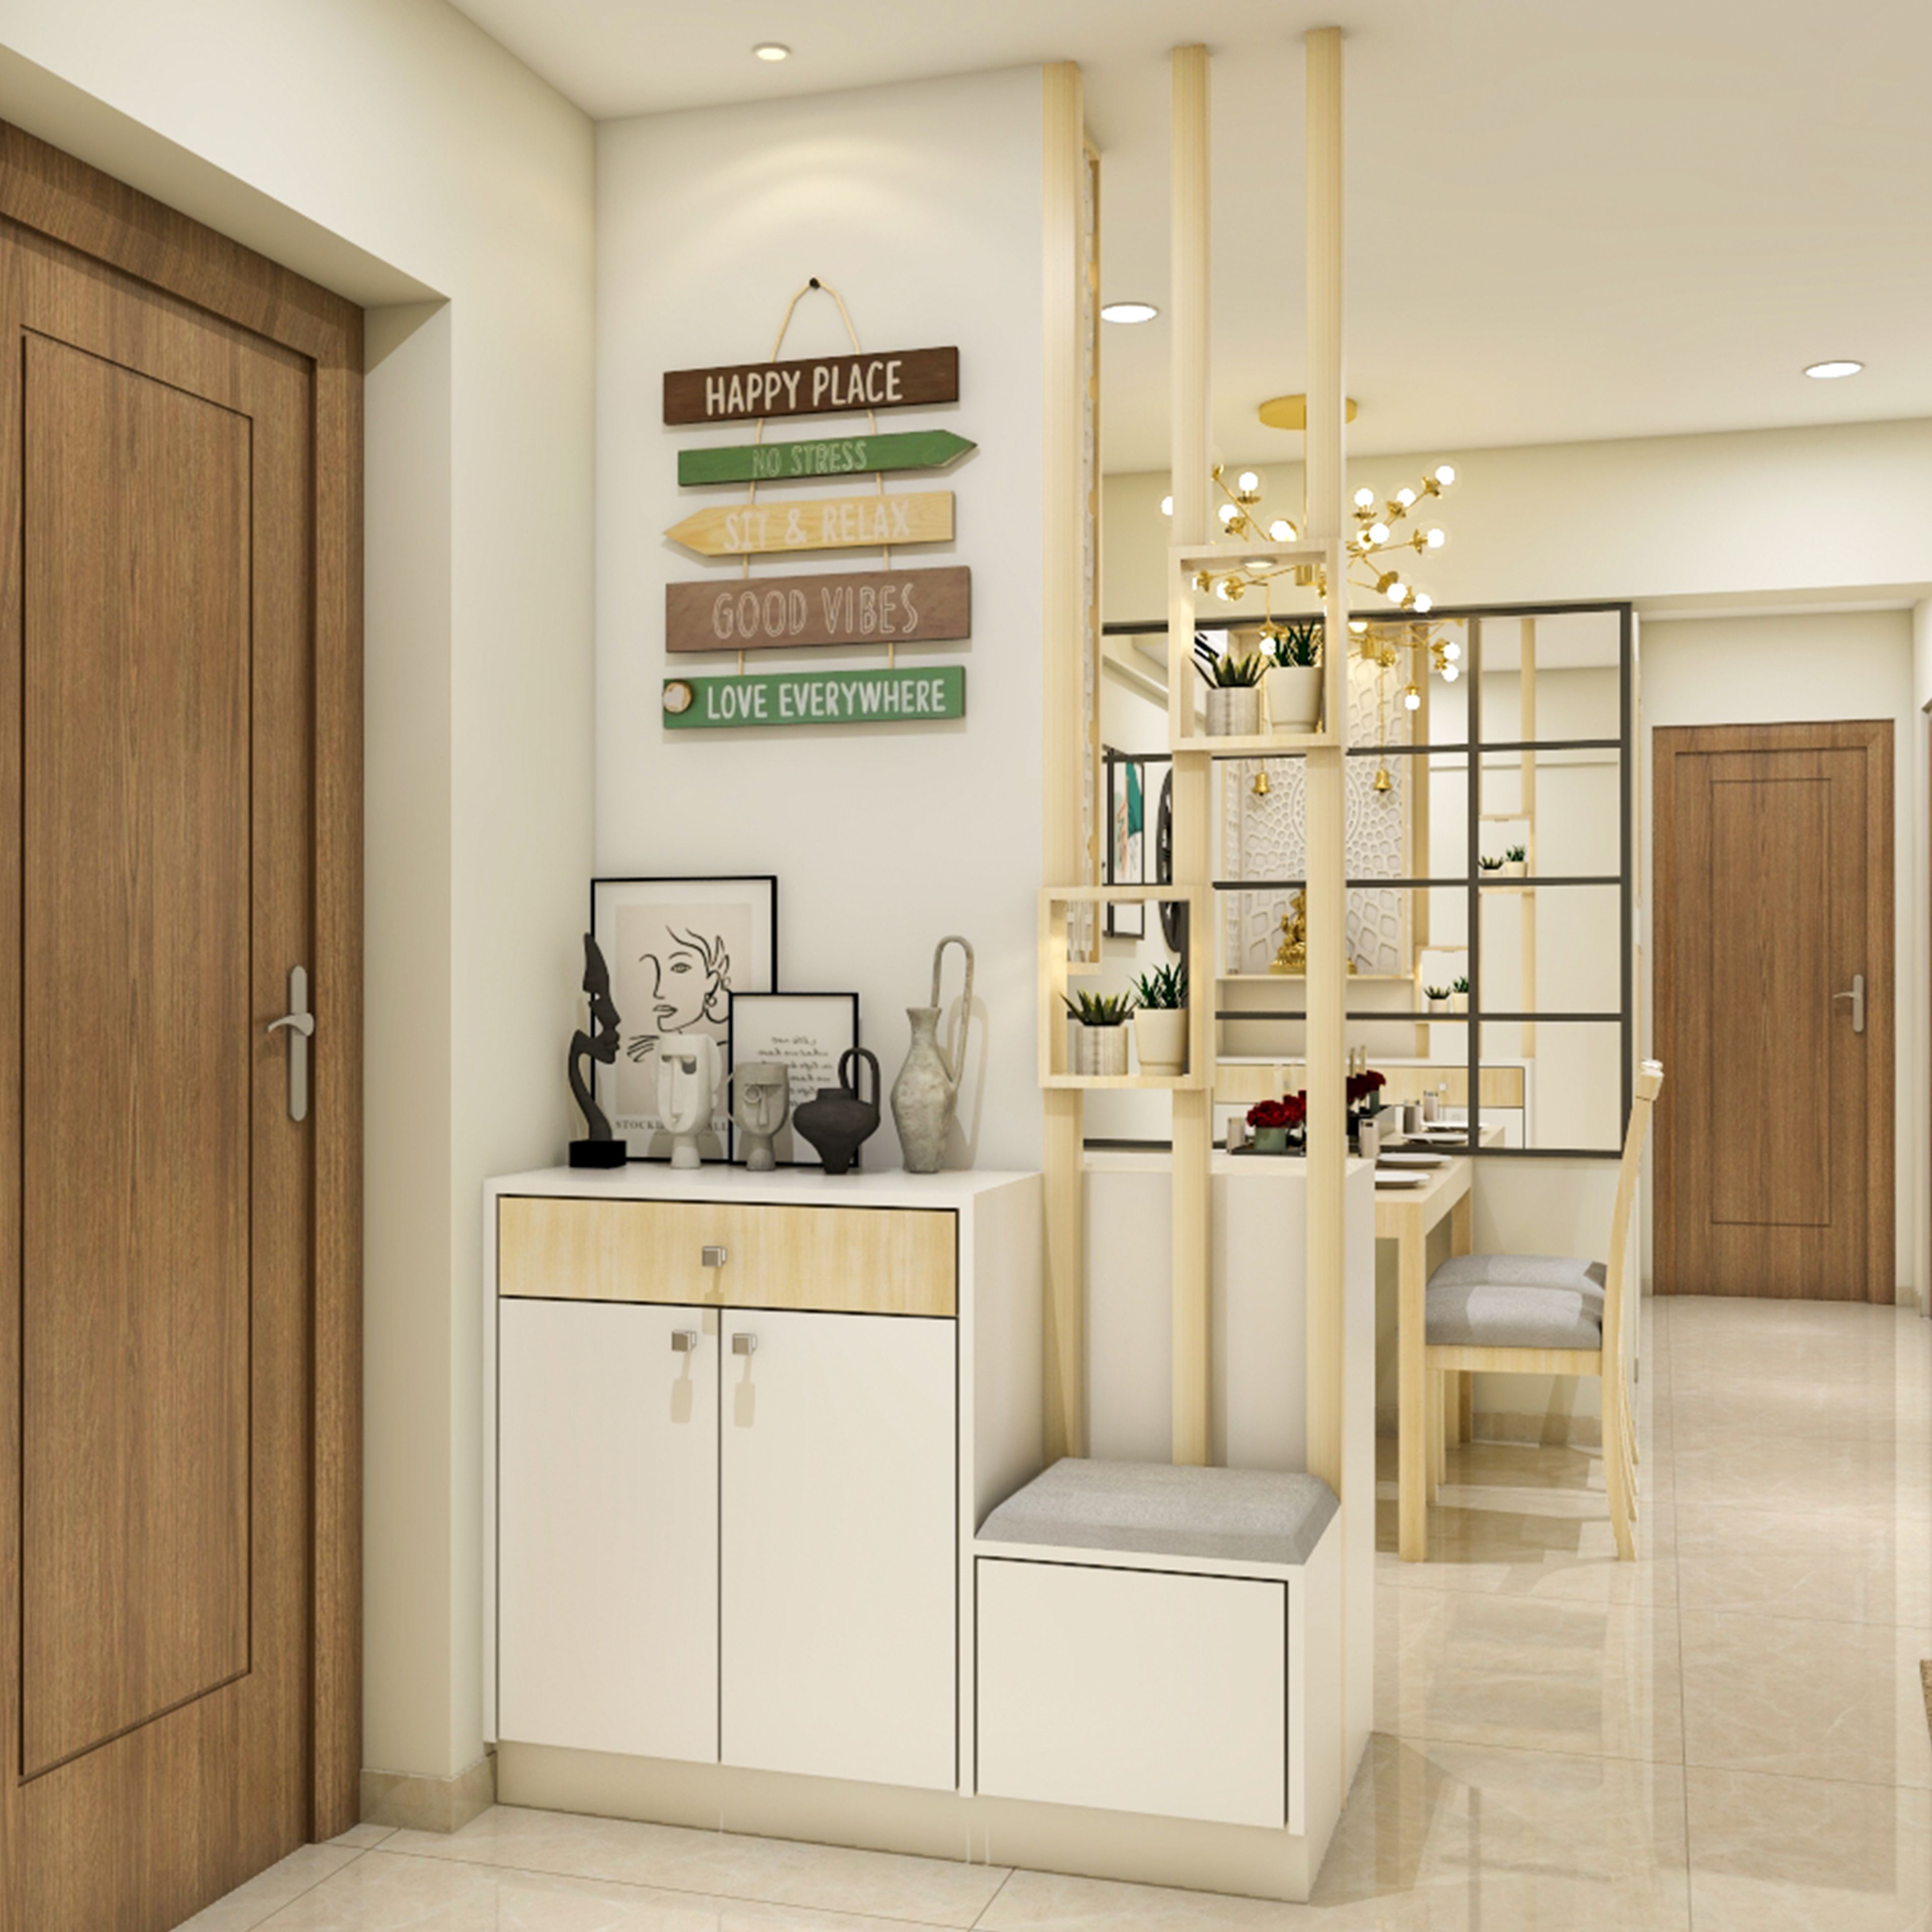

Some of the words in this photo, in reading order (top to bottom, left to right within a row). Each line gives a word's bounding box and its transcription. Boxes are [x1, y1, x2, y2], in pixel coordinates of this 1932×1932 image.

[706, 371, 800, 416] HAPPY
[813, 360, 903, 407] PLACE
[753, 448, 780, 477] NO
[791, 441, 867, 474] STRESS
[725, 511, 768, 551] SIT
[786, 509, 806, 544] &
[823, 502, 910, 542] RELAX
[712, 589, 806, 638] GOOD
[822, 583, 918, 634] VIBES
[707, 683, 768, 719] LOVE
[779, 679, 945, 717] EVERYWHERE
